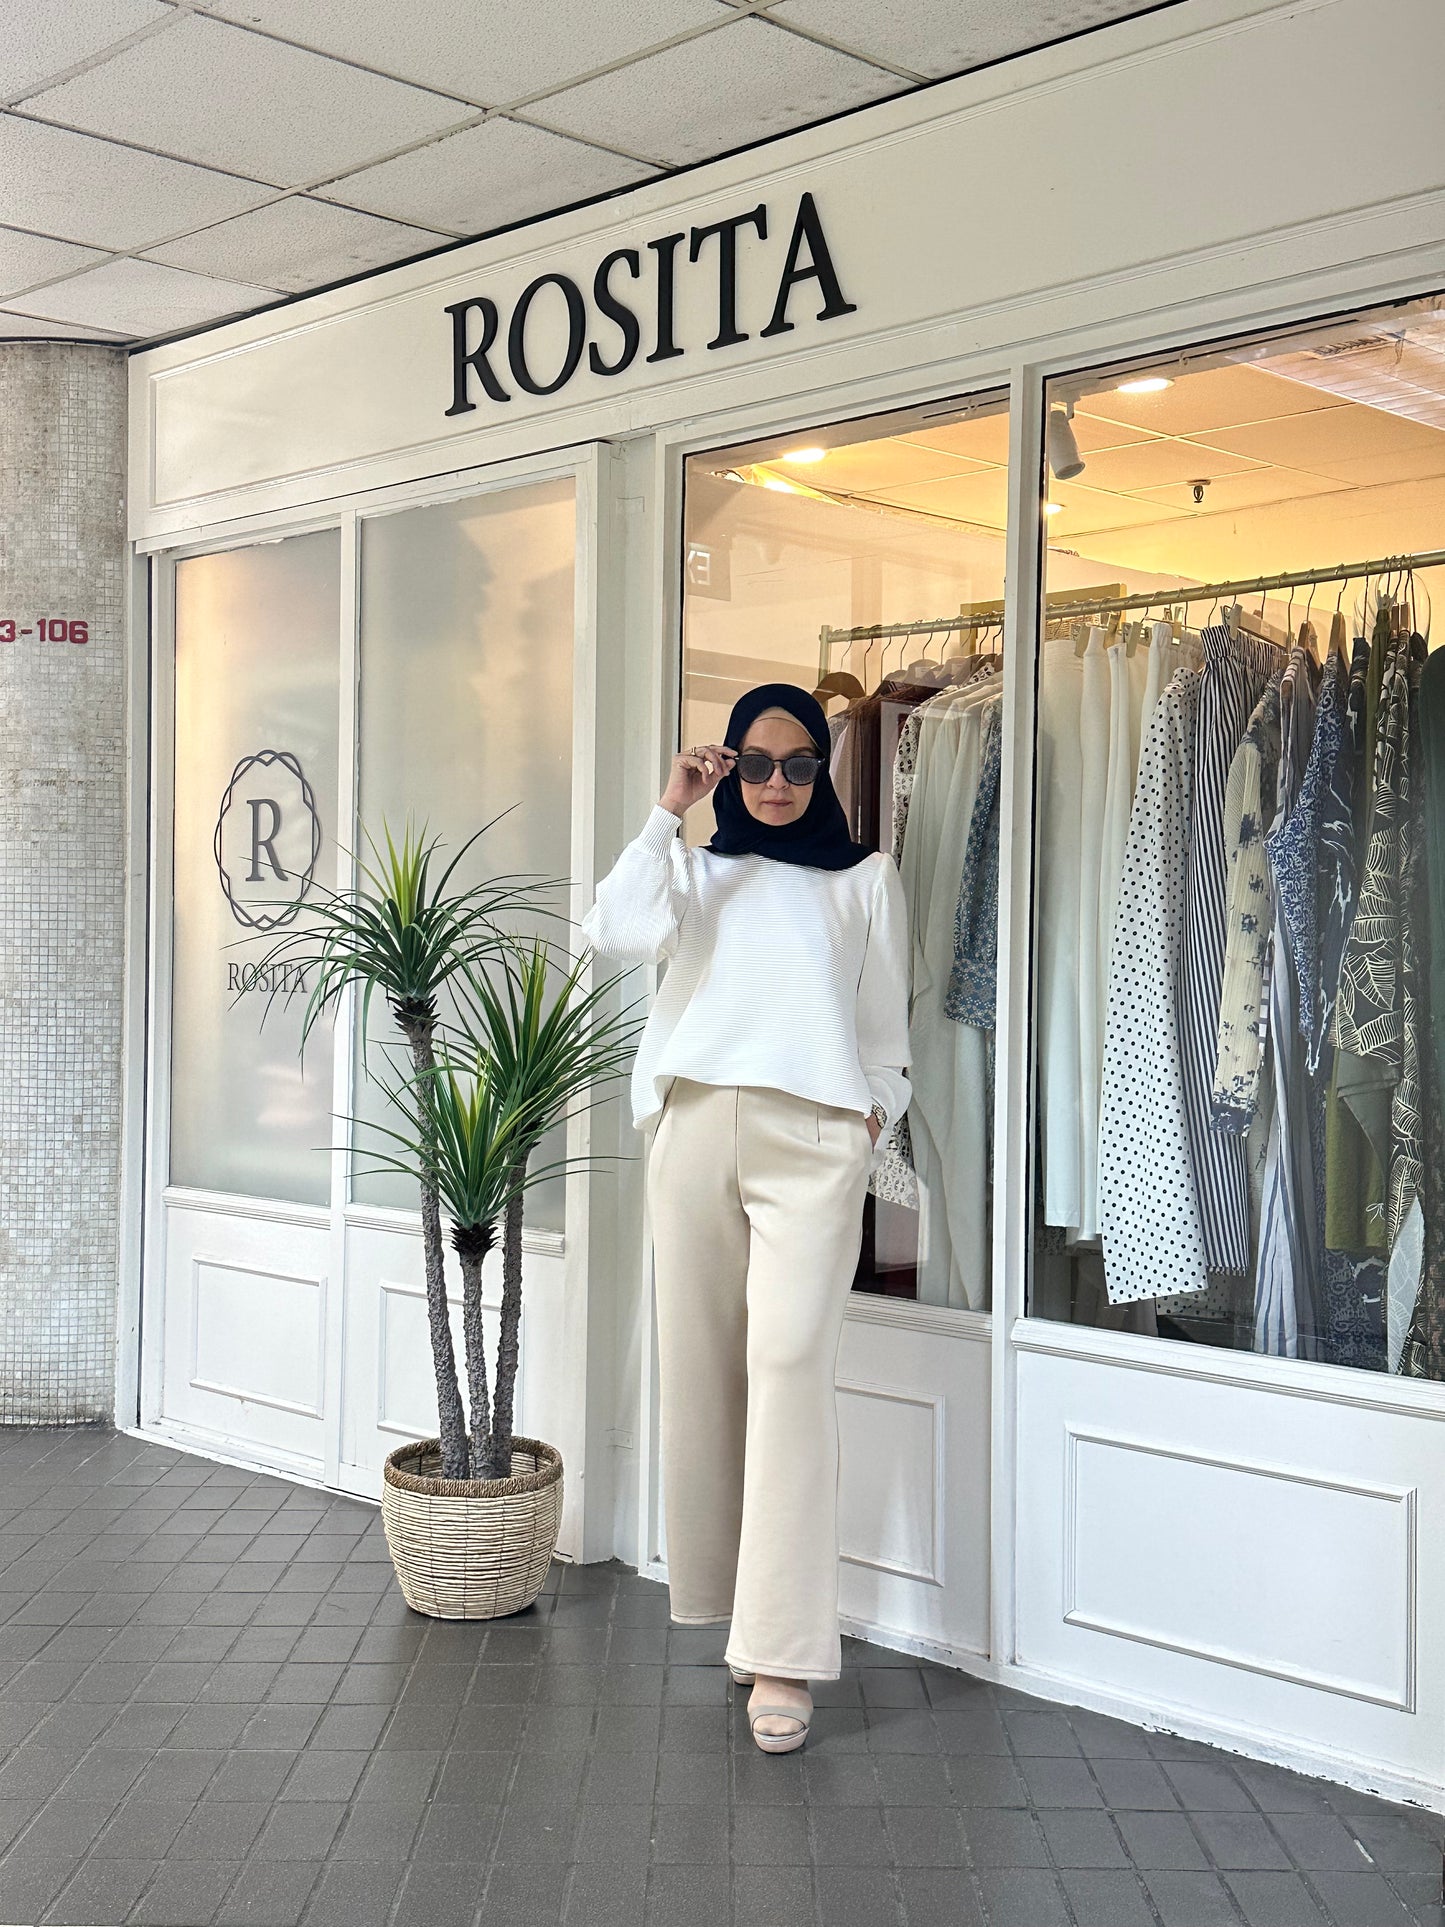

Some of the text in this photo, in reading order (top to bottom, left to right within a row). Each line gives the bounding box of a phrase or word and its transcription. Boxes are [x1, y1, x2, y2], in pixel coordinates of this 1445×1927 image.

[444, 192, 857, 416] ROSITA
[245, 798, 289, 882] R
[227, 962, 308, 993] ROSITA
